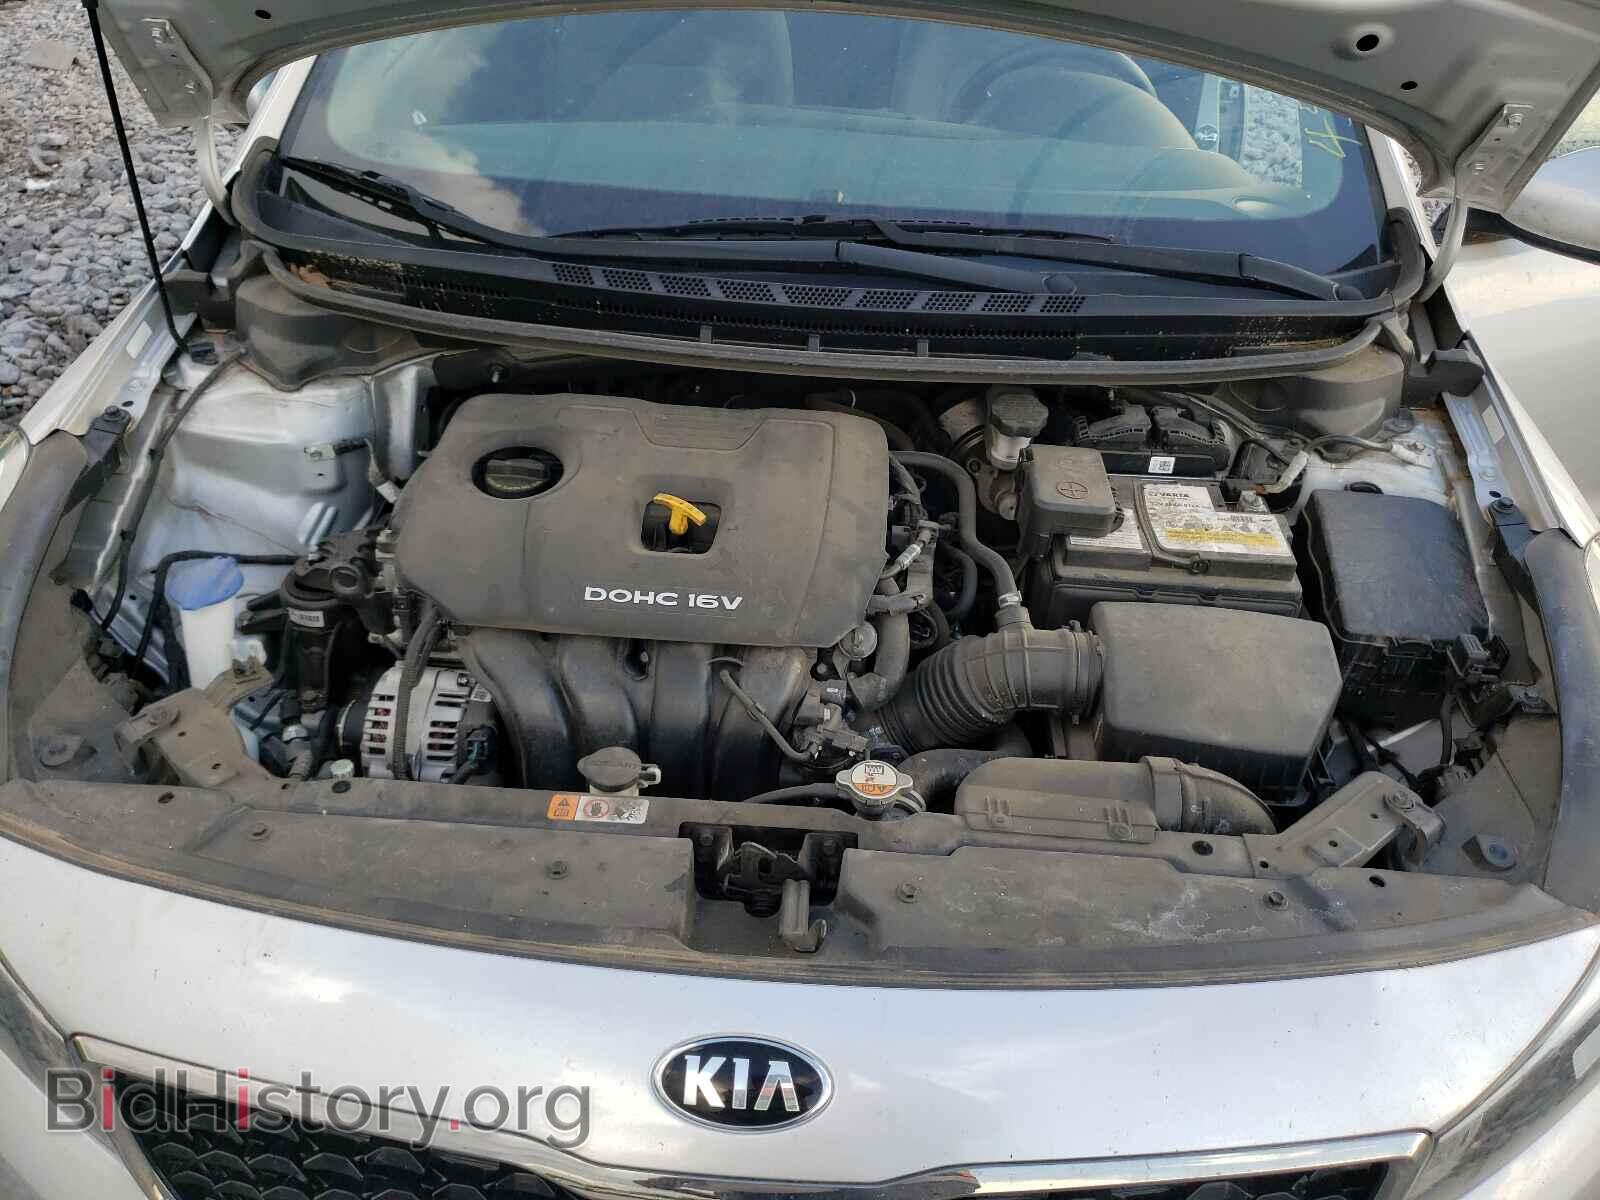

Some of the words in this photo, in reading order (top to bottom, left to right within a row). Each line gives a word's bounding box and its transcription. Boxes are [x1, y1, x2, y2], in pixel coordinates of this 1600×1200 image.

[584, 586, 679, 606] DOHC
[688, 593, 743, 610] 16V
[683, 1055, 800, 1111] KIA
